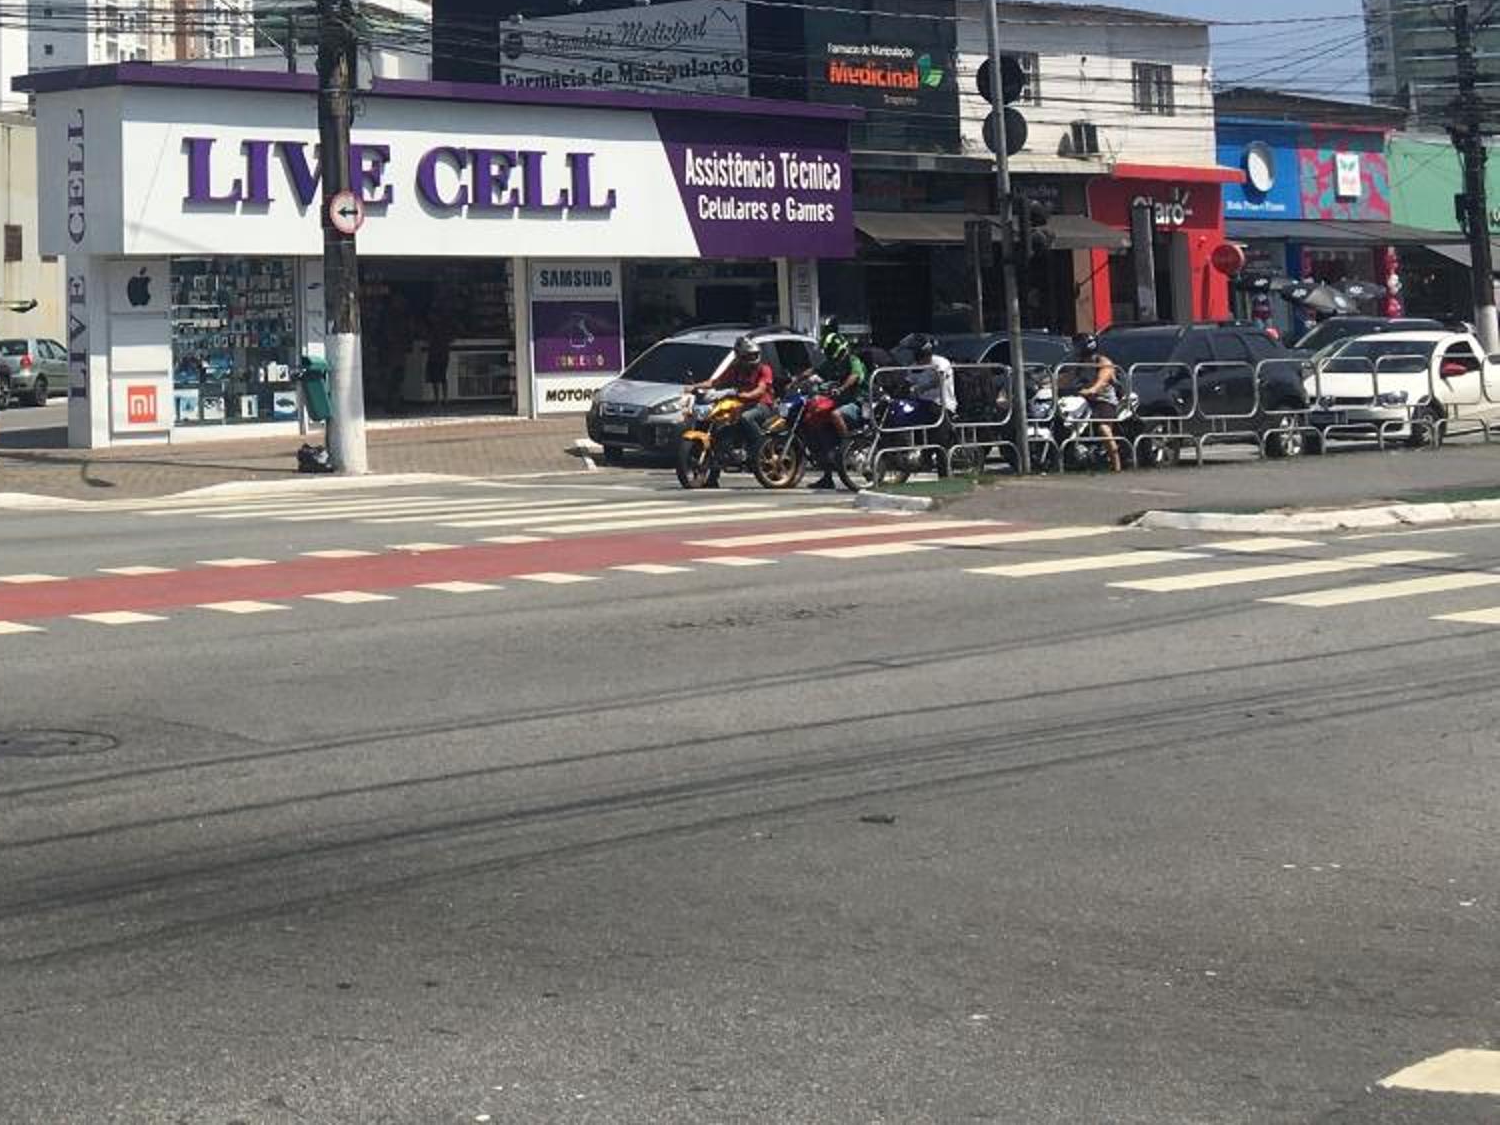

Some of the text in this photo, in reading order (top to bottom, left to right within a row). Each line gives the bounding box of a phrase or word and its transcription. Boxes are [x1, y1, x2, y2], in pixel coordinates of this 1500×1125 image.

[828, 60, 919, 89] Medicinal
[67, 108, 86, 244] CELL
[182, 136, 617, 210] LIVE CELL
[685, 148, 841, 191] Assistência Técnica
[698, 194, 835, 222] Celulares e Games
[539, 269, 613, 287] SAMSUNG
